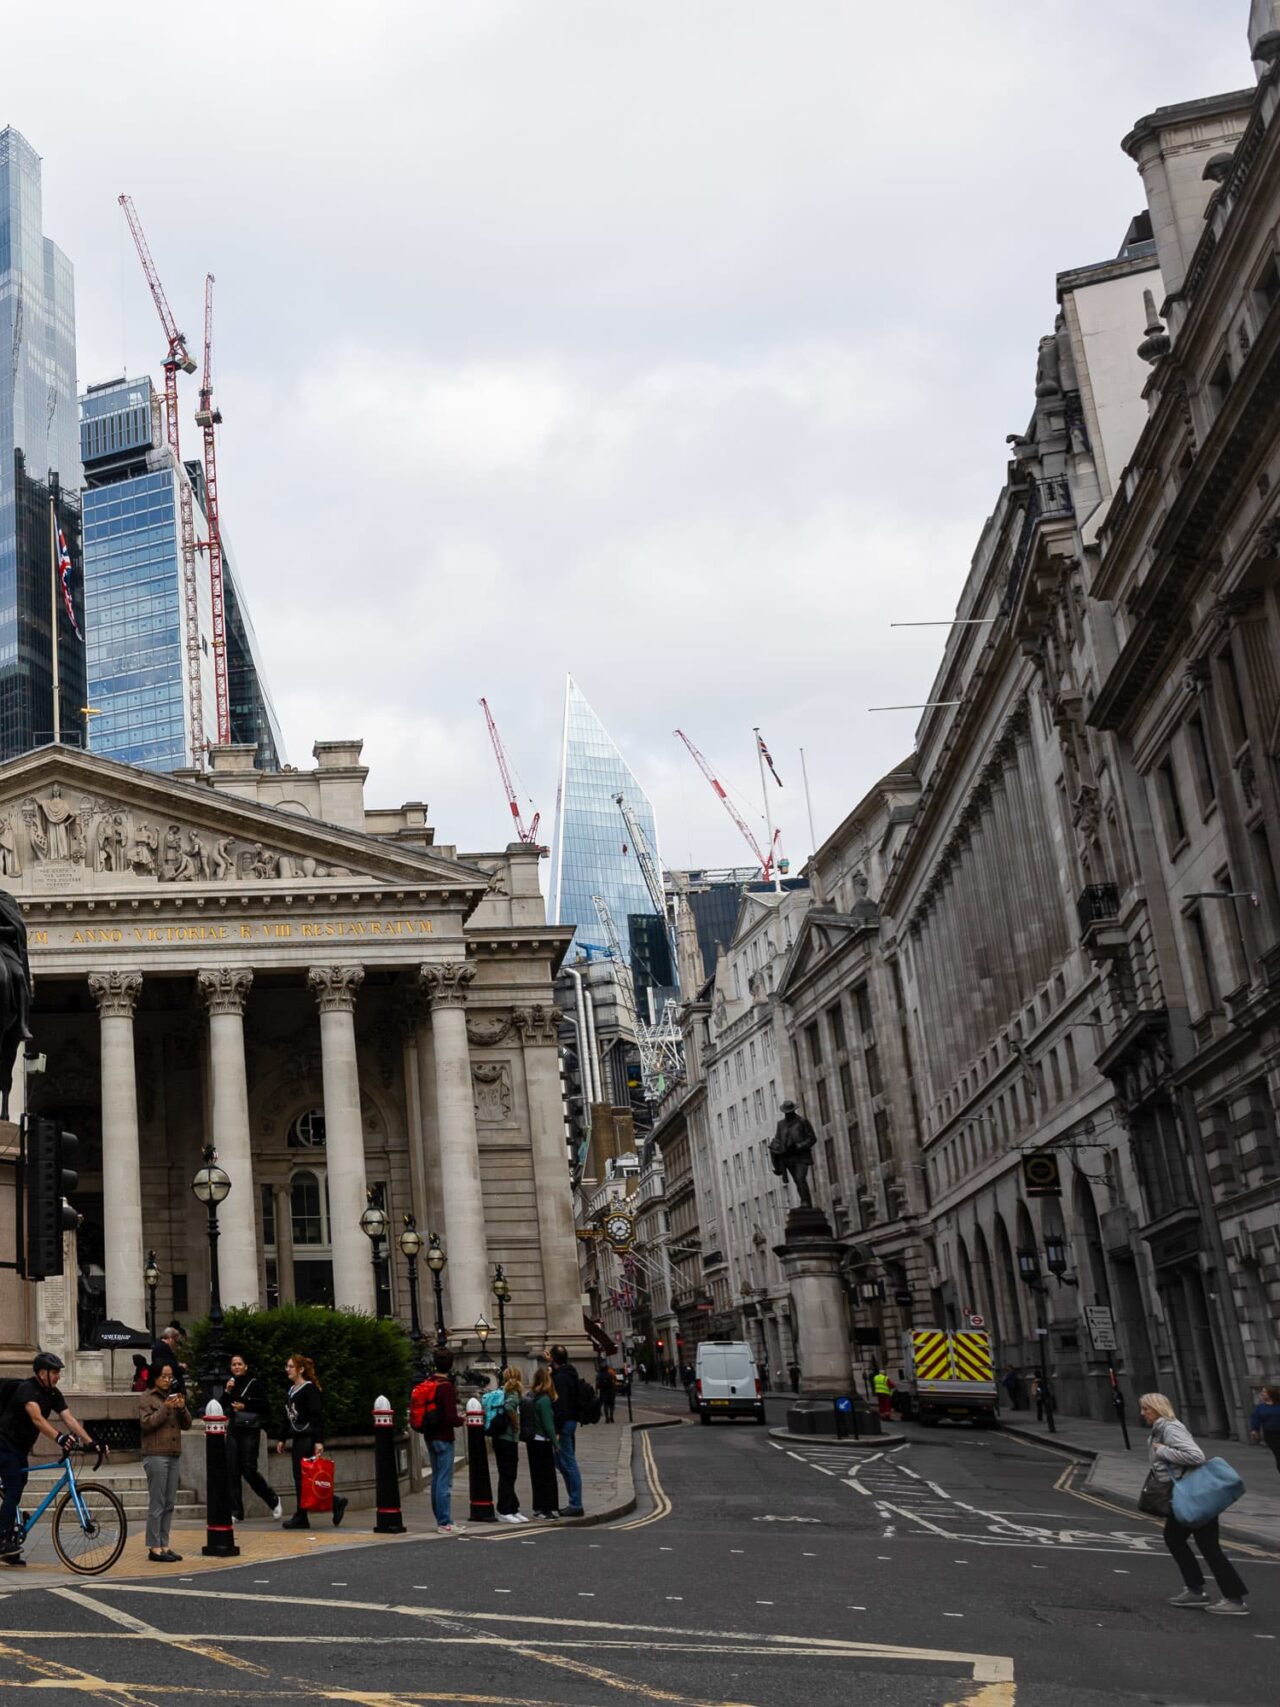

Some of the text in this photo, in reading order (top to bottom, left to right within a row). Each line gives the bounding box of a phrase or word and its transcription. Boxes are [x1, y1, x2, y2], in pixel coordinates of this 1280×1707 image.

[70, 928, 122, 944] ANNO
[133, 925, 229, 942] VICTORIAE
[301, 919, 433, 938] RESTAVRATVM
